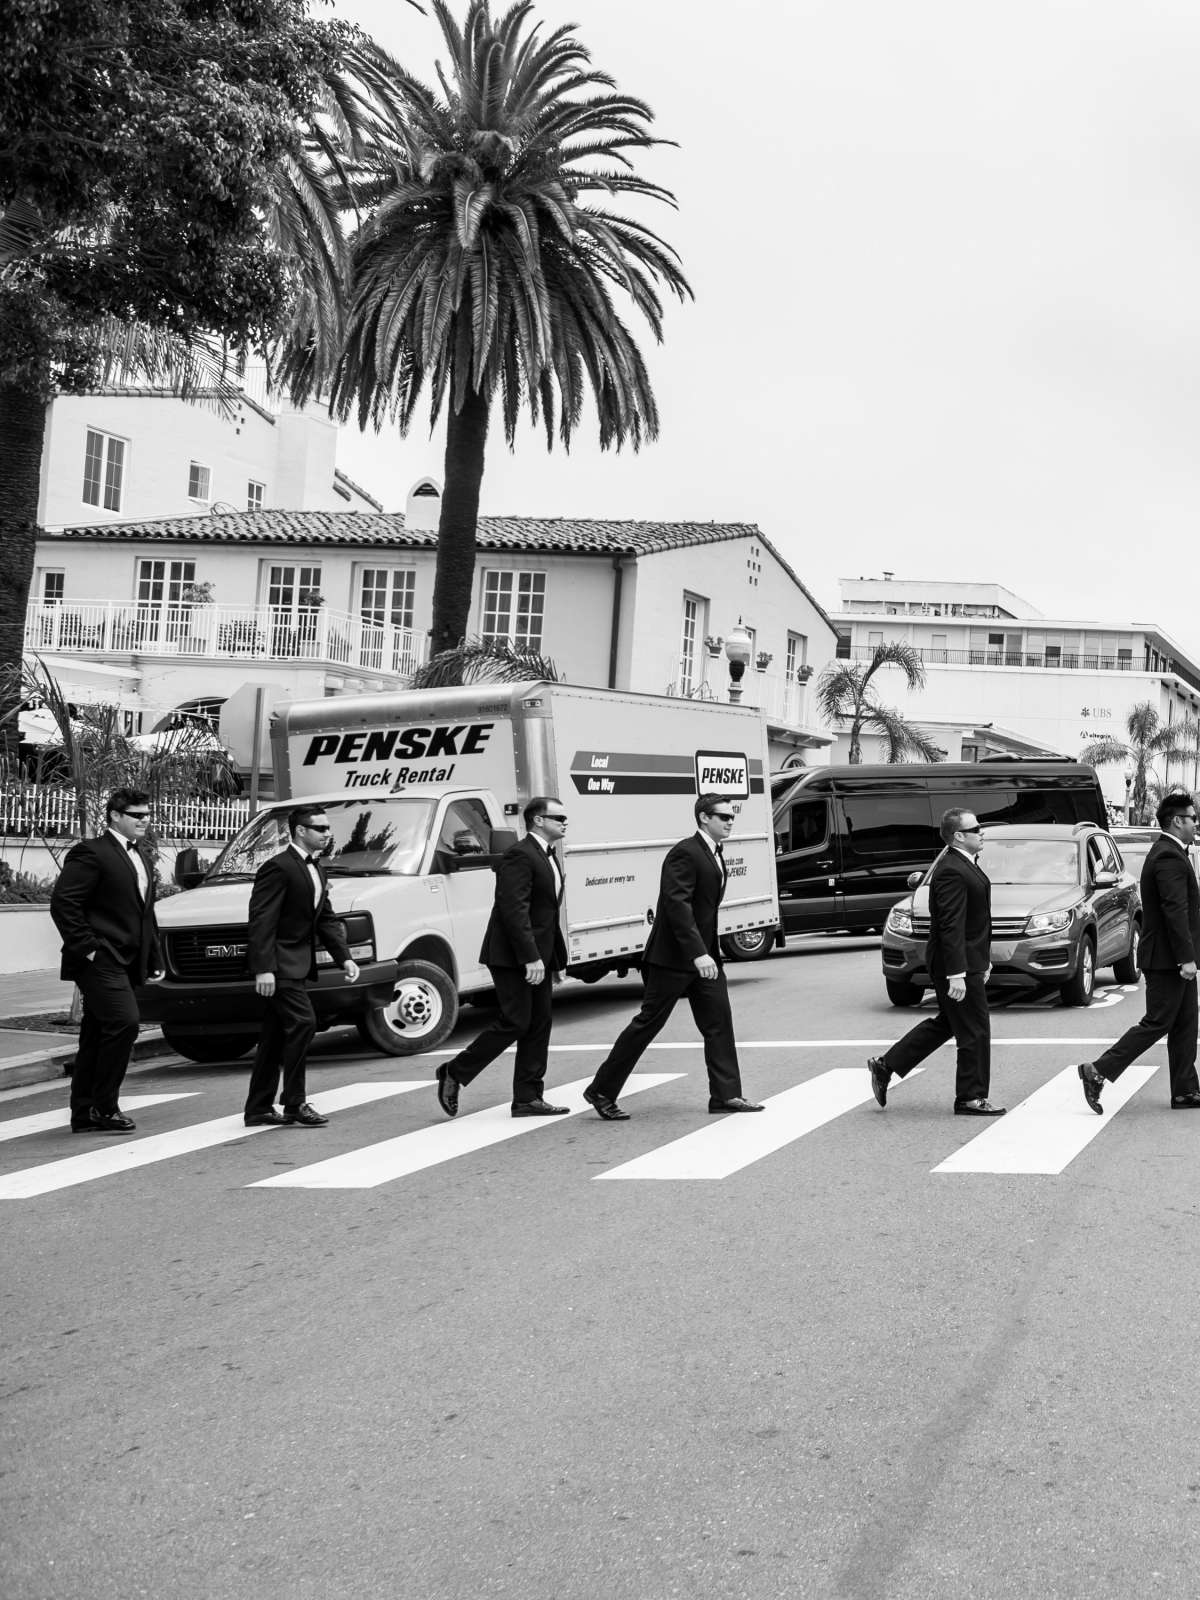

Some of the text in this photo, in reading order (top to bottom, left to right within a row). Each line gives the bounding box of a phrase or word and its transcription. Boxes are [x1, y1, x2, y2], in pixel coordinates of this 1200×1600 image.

[1093, 708, 1112, 719] UBS
[303, 723, 494, 766] PENSKE
[591, 755, 609, 768] Local
[344, 763, 456, 788] Truck Rental
[702, 768, 745, 784] PENSKE
[588, 778, 615, 793] One Way
[585, 877, 608, 887] Dedication
[614, 876, 626, 885] every
[206, 944, 248, 958] GMC
